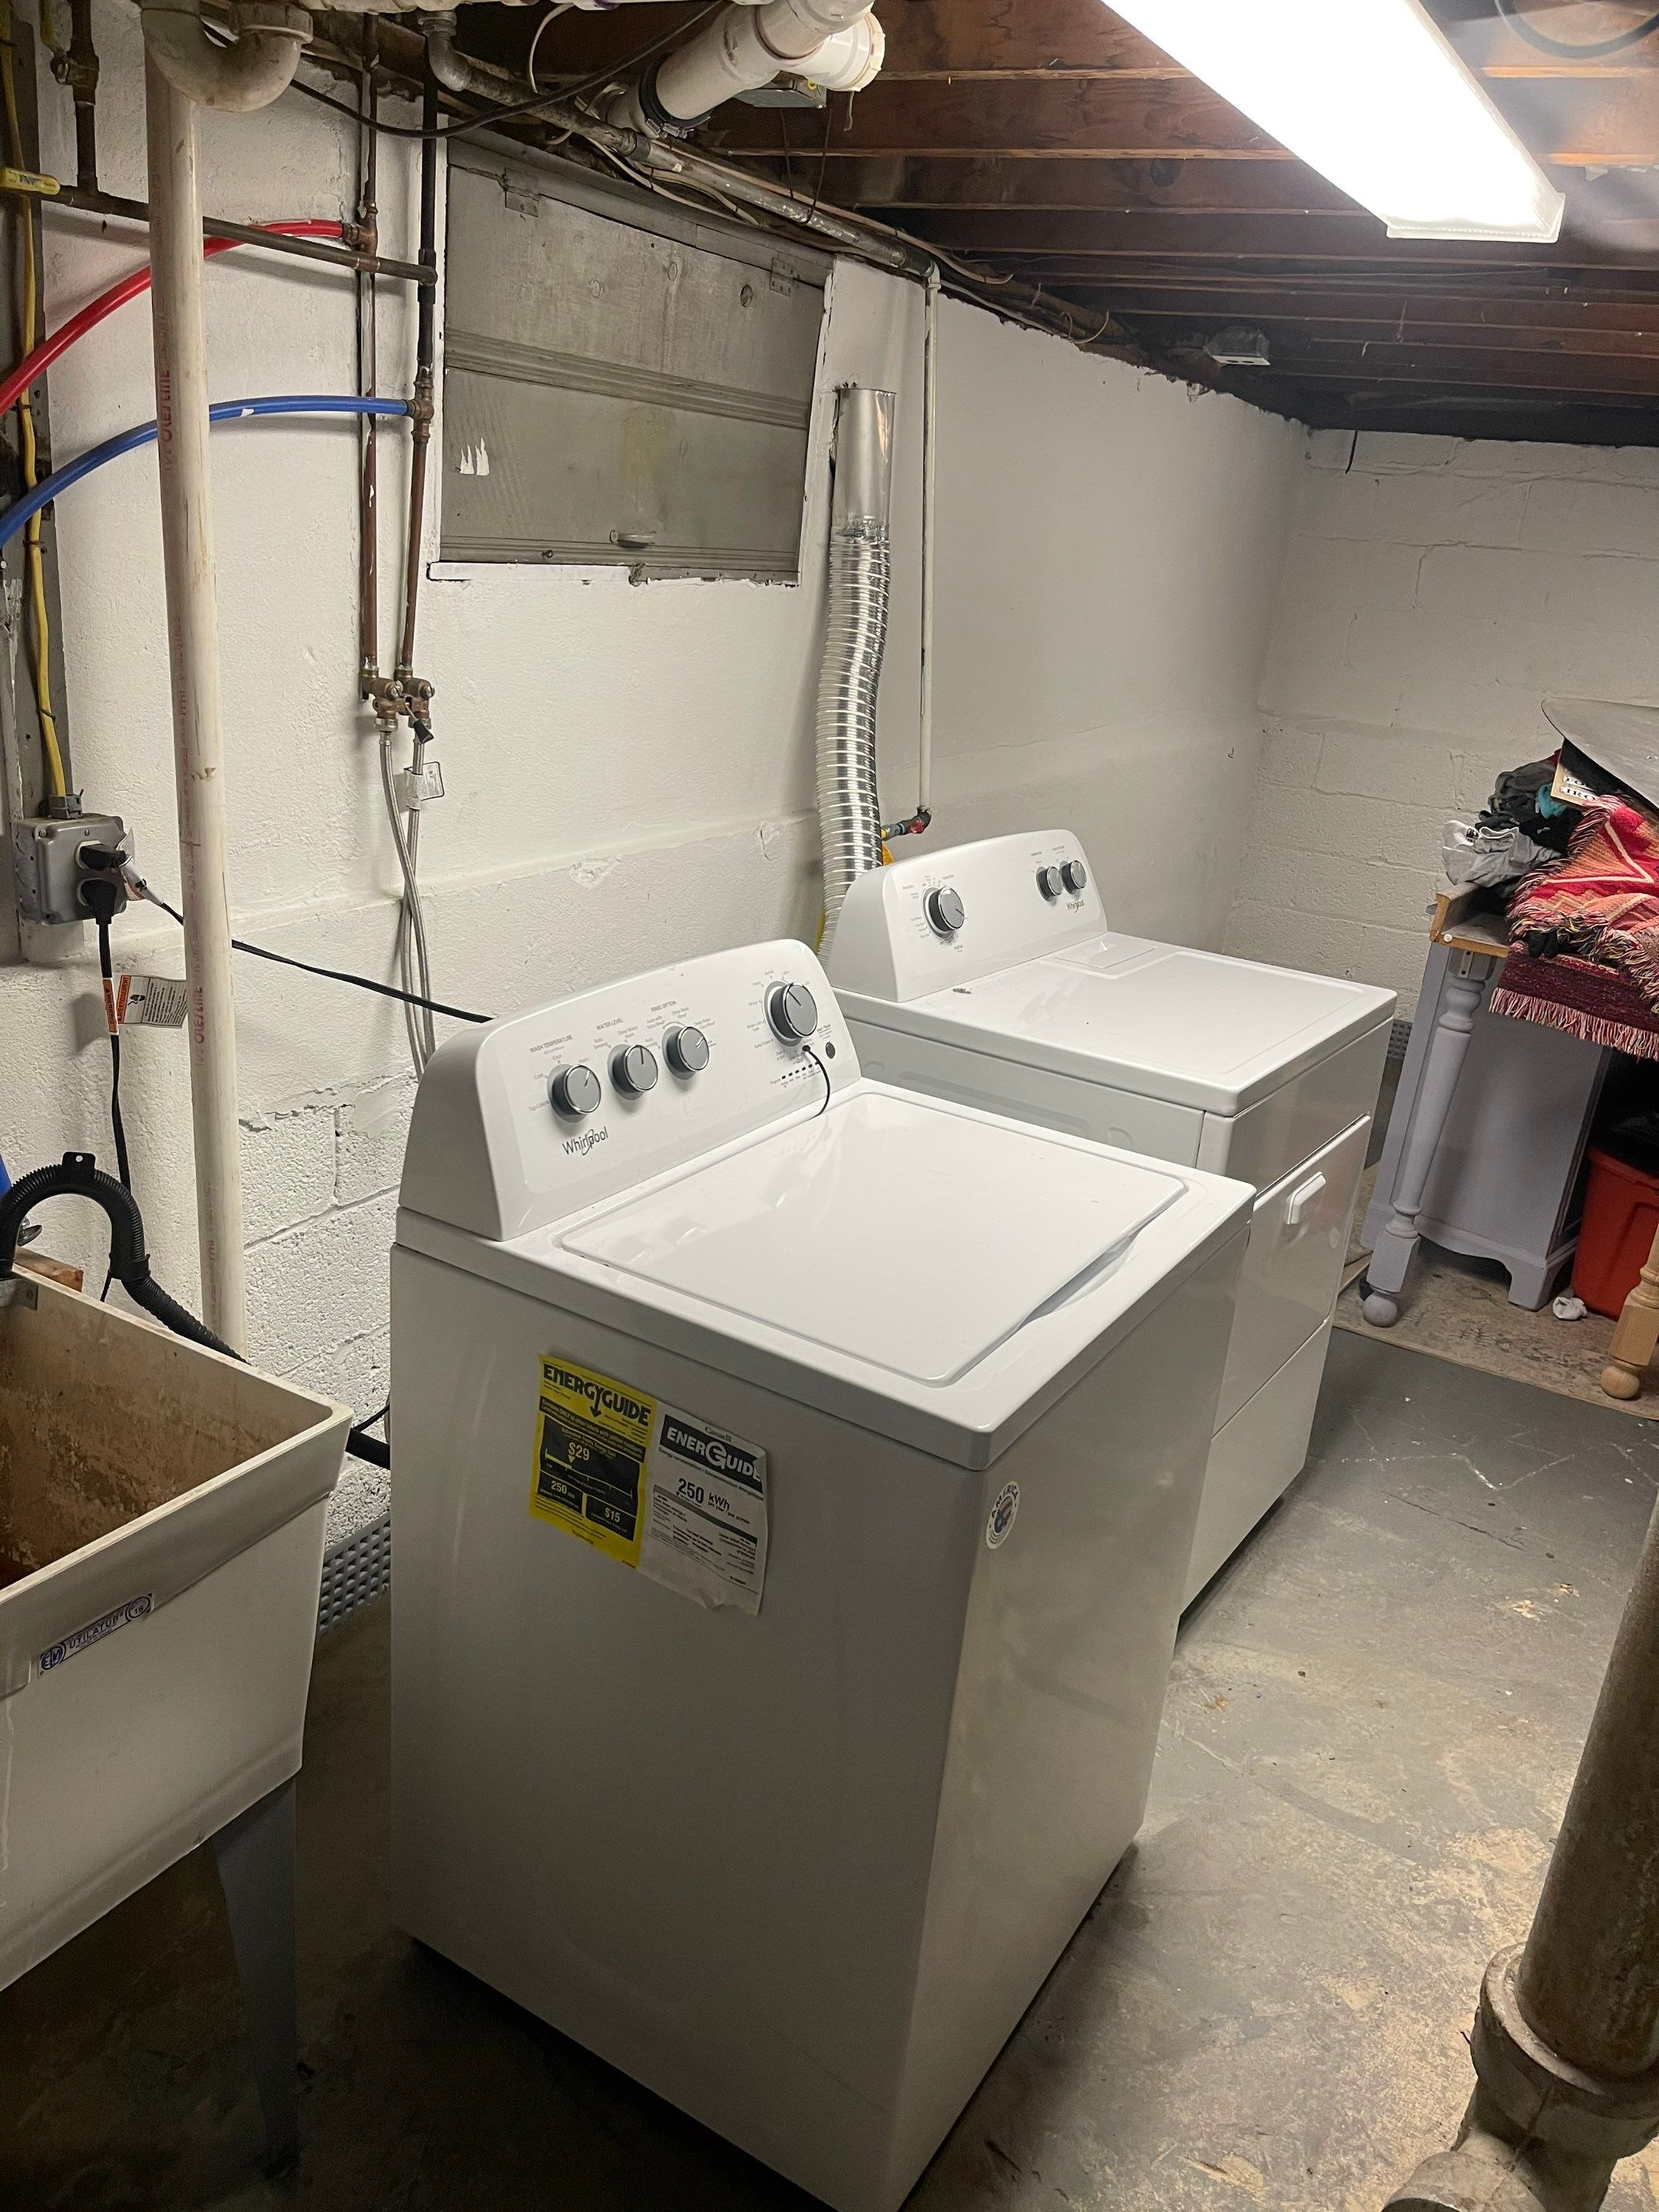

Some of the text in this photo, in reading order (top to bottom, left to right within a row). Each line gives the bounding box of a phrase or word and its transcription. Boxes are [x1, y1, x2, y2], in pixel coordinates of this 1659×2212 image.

[562, 1126, 609, 1156] Whirlpool
[543, 1363, 651, 1426] ENERGYGUIDE
[568, 1442, 590, 1461] $29
[551, 1480, 568, 1495] 250
[678, 1477, 730, 1510] 250 kWh
[604, 1507, 621, 1523] $15
[69, 1615, 119, 1649] UTILATUB
